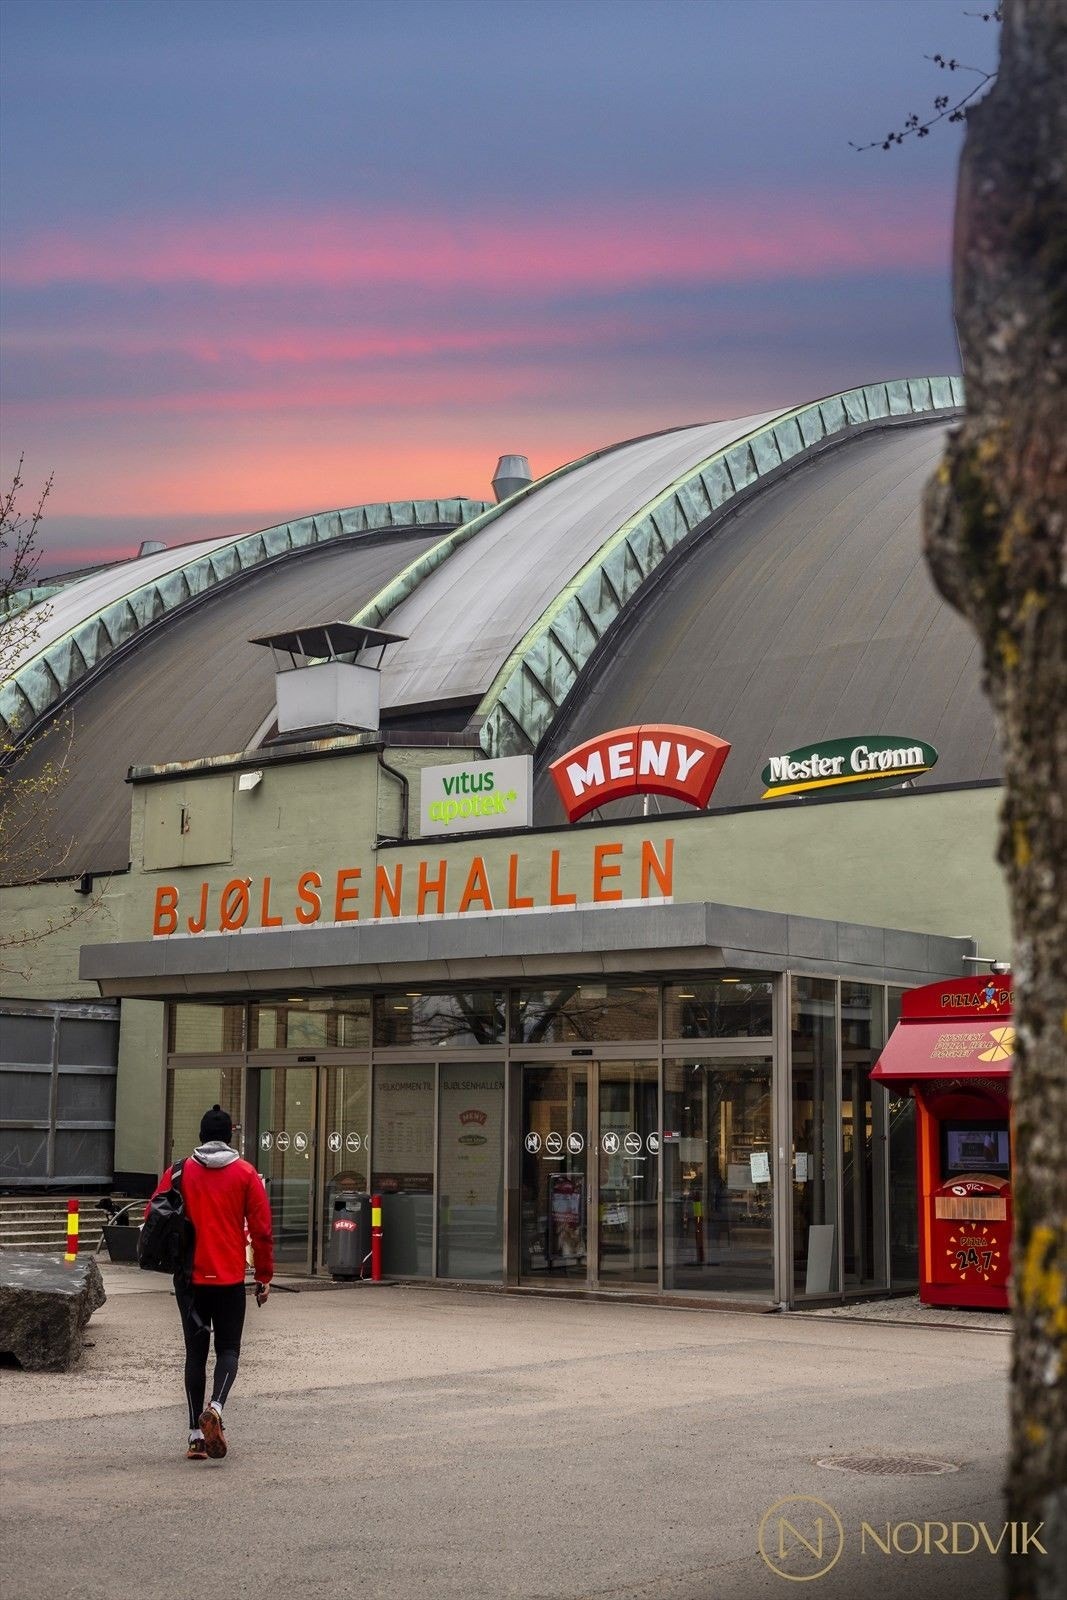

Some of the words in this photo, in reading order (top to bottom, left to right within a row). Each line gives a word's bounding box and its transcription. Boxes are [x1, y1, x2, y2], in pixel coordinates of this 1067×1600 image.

[566, 740, 705, 797] MENY
[769, 753, 845, 783] Mester
[850, 745, 925, 772] Grønn
[442, 771, 495, 796] vitus
[153, 838, 675, 936] BJØLSENHALLEN
[941, 992, 981, 1008] PIZZA
[423, 1081, 433, 1091] TIL
[335, 1221, 354, 1230] MENY
[960, 1236, 988, 1247] PIZZA
